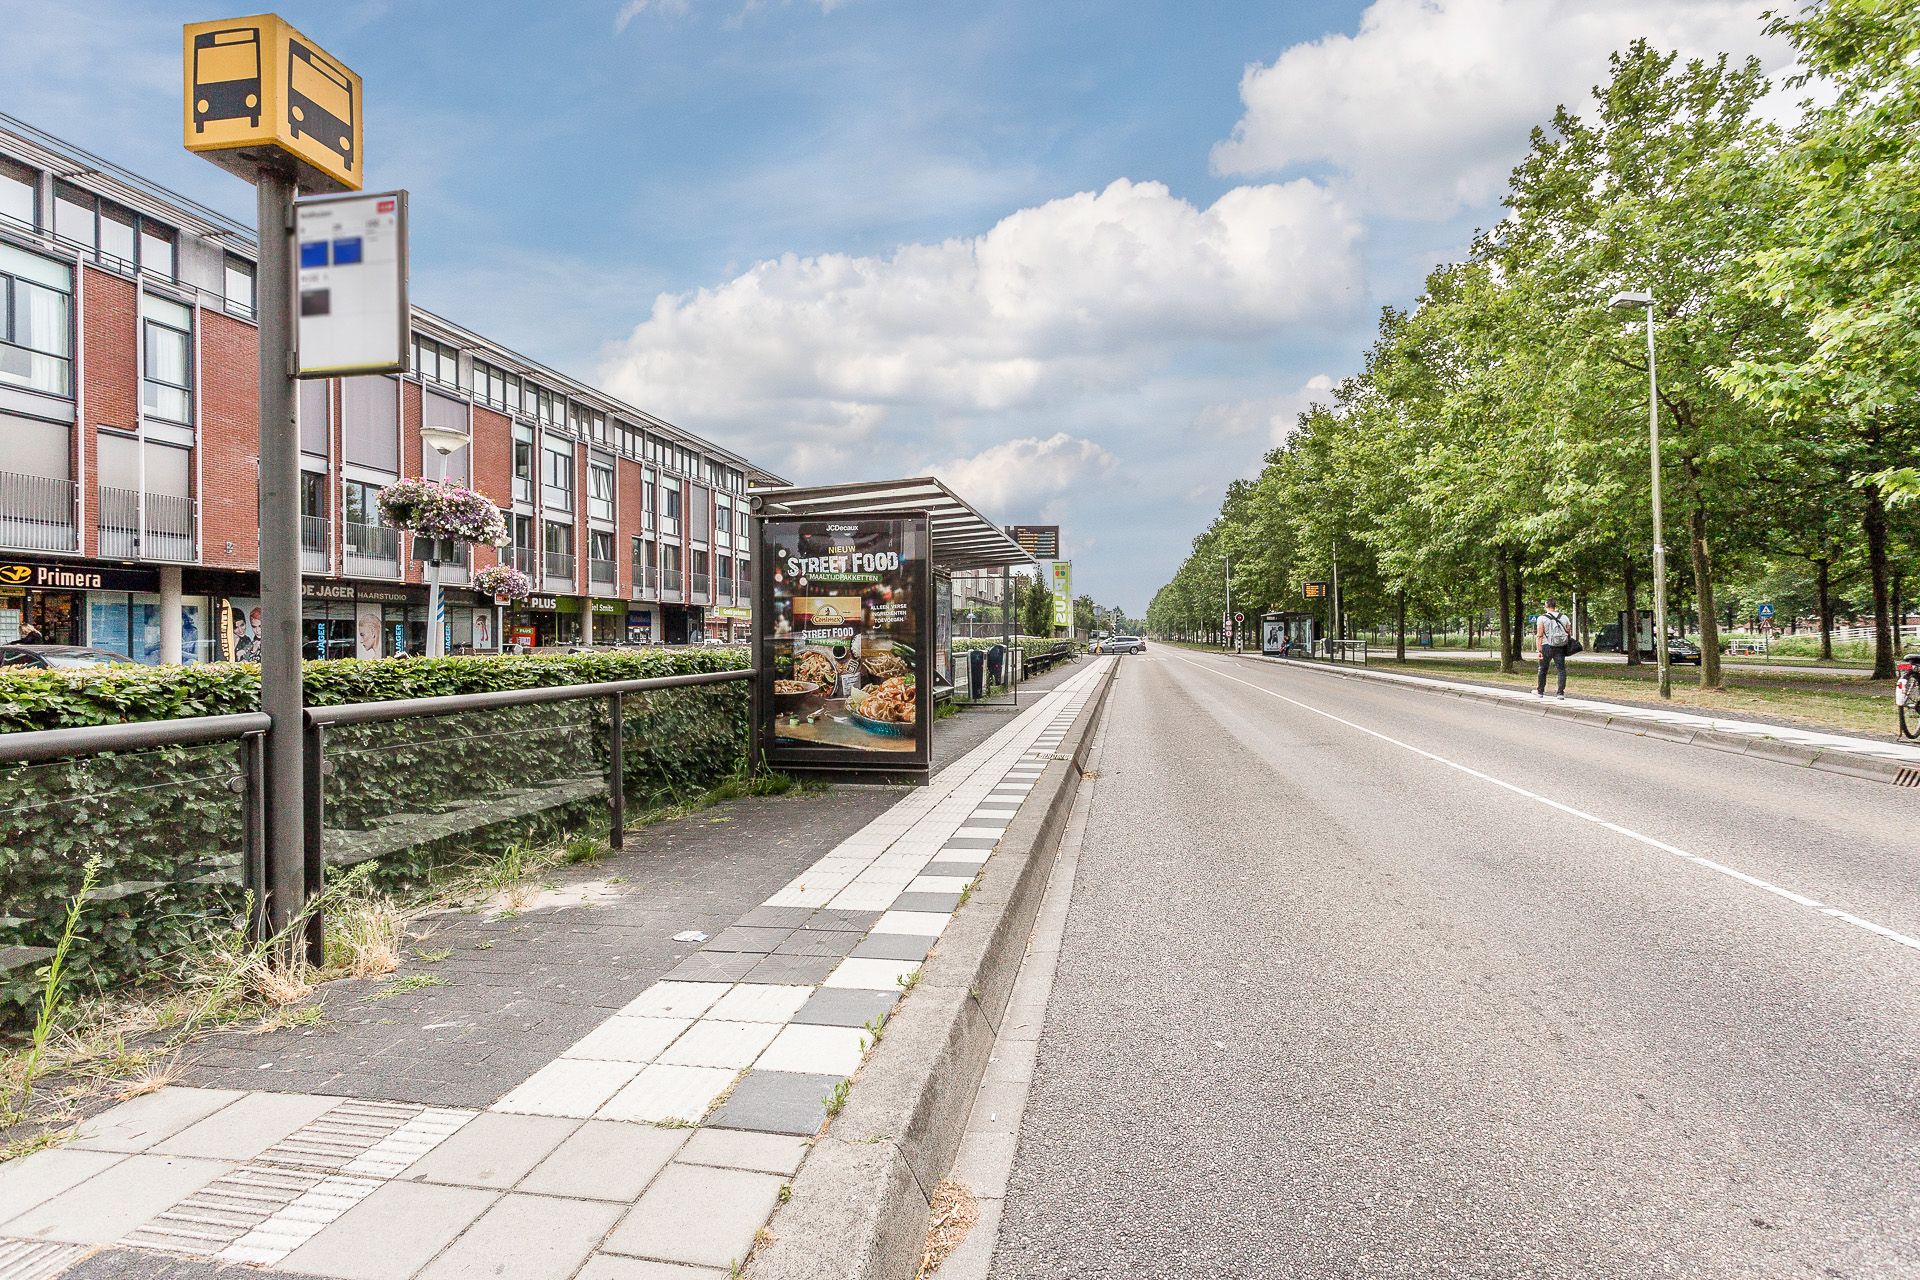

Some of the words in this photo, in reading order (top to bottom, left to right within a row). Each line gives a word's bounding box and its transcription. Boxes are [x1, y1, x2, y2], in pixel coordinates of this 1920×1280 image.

[828, 546, 856, 554] NIEUW
[788, 557, 848, 577] STREET
[852, 552, 899, 572] FOOD
[38, 567, 101, 588] Primera
[809, 574, 878, 582] MAALTIJDPAKKETTEN
[316, 585, 355, 598] JAGER
[357, 591, 407, 601] HAARSTUDIO
[531, 597, 557, 609] PLUS
[802, 630, 831, 639] STREET
[833, 628, 853, 636] FOOD
